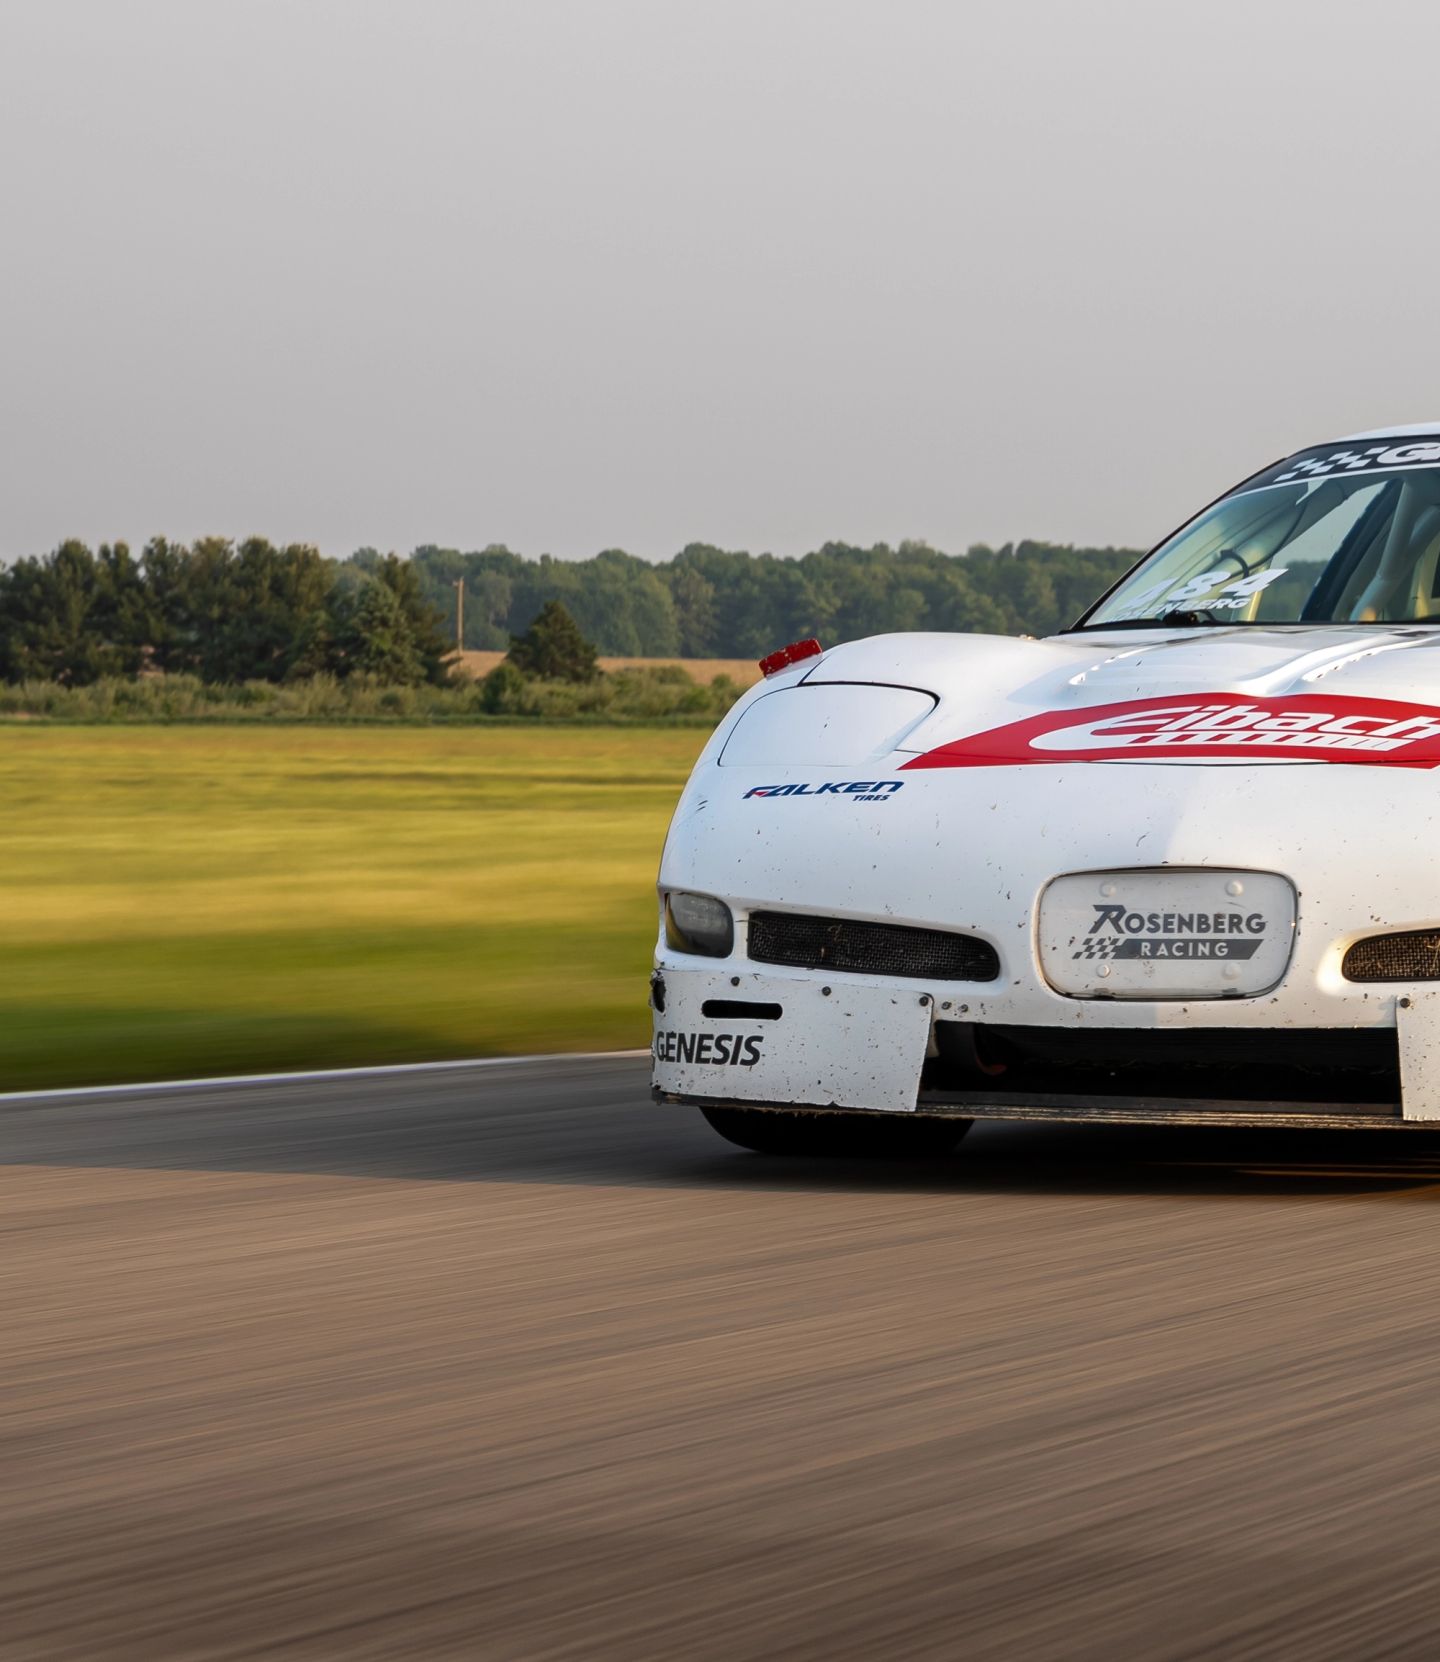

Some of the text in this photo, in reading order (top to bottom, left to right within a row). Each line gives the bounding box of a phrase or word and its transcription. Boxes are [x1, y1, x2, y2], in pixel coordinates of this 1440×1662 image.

[1116, 568, 1288, 610] 484
[742, 781, 904, 799] FALKEN
[852, 794, 891, 802] TIRES
[1088, 905, 1267, 934] ROSENBERG
[1141, 942, 1229, 957] RACING
[656, 1031, 764, 1067] GENESIS
